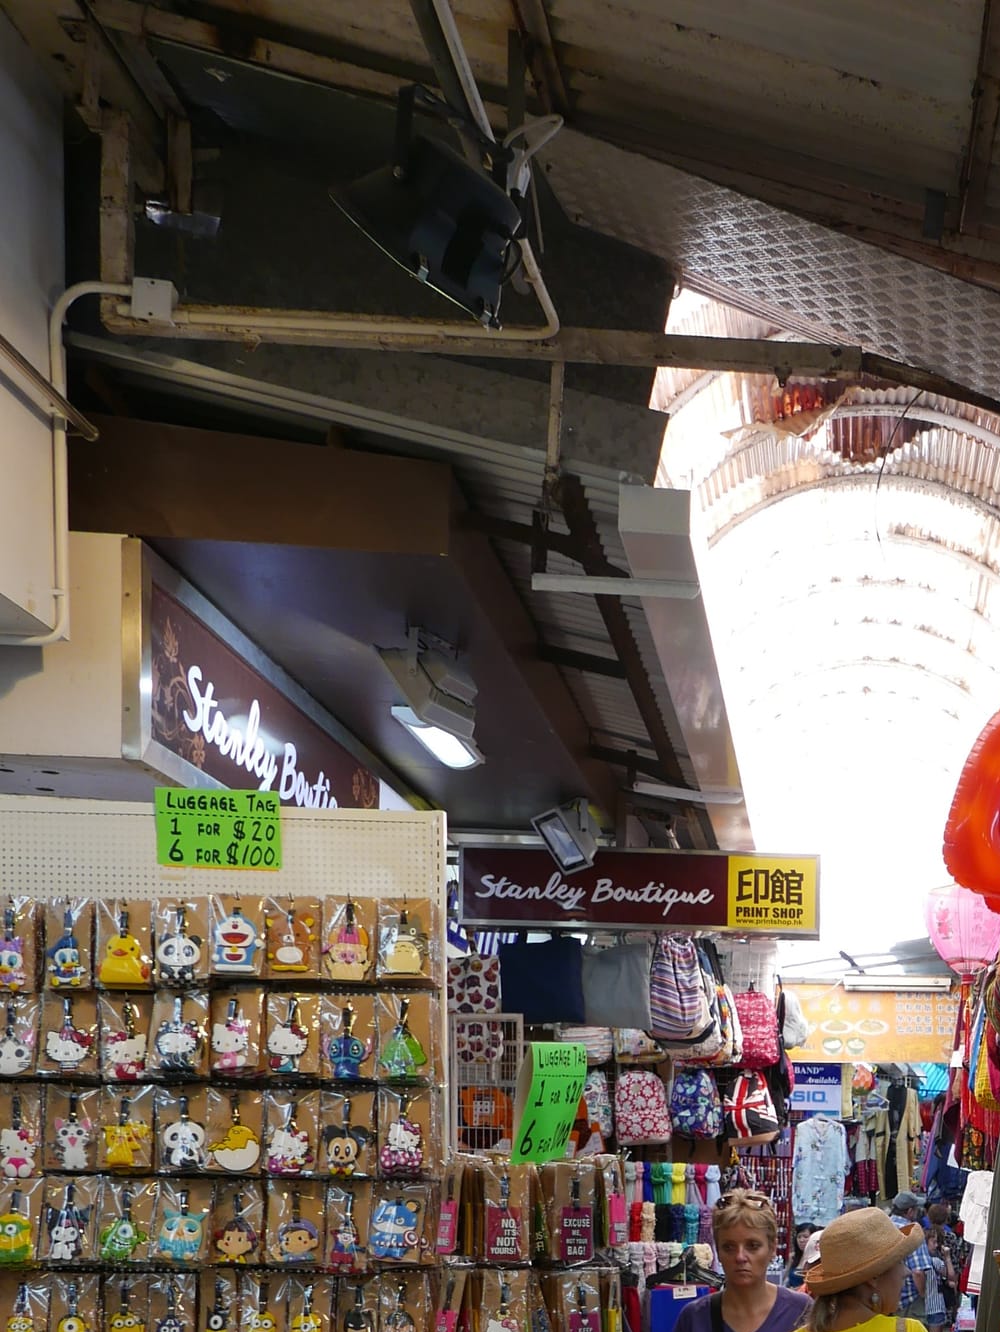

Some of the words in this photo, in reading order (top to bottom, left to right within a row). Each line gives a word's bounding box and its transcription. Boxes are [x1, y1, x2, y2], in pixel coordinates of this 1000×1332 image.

[183, 665, 278, 791] Stanley
[167, 792, 238, 812] LUGGAGE
[246, 794, 277, 813] TAG
[170, 818, 182, 836] 1
[197, 823, 221, 836] FOR
[168, 839, 184, 862] 6
[196, 849, 222, 864] FOR
[475, 871, 586, 911] Stanley
[590, 878, 715, 916] Boutique
[735, 868, 804, 906] 印館
[735, 906, 771, 918] PRINT
[772, 907, 804, 919] SHOP
[533, 1080, 546, 1108] 1
[519, 1119, 537, 1156] 6
[563, 1218, 591, 1228] EXCUSE
[490, 1247, 517, 1255] YOURS!
[496, 1237, 516, 1247] NOT
[567, 1247, 586, 1256] BAG!
